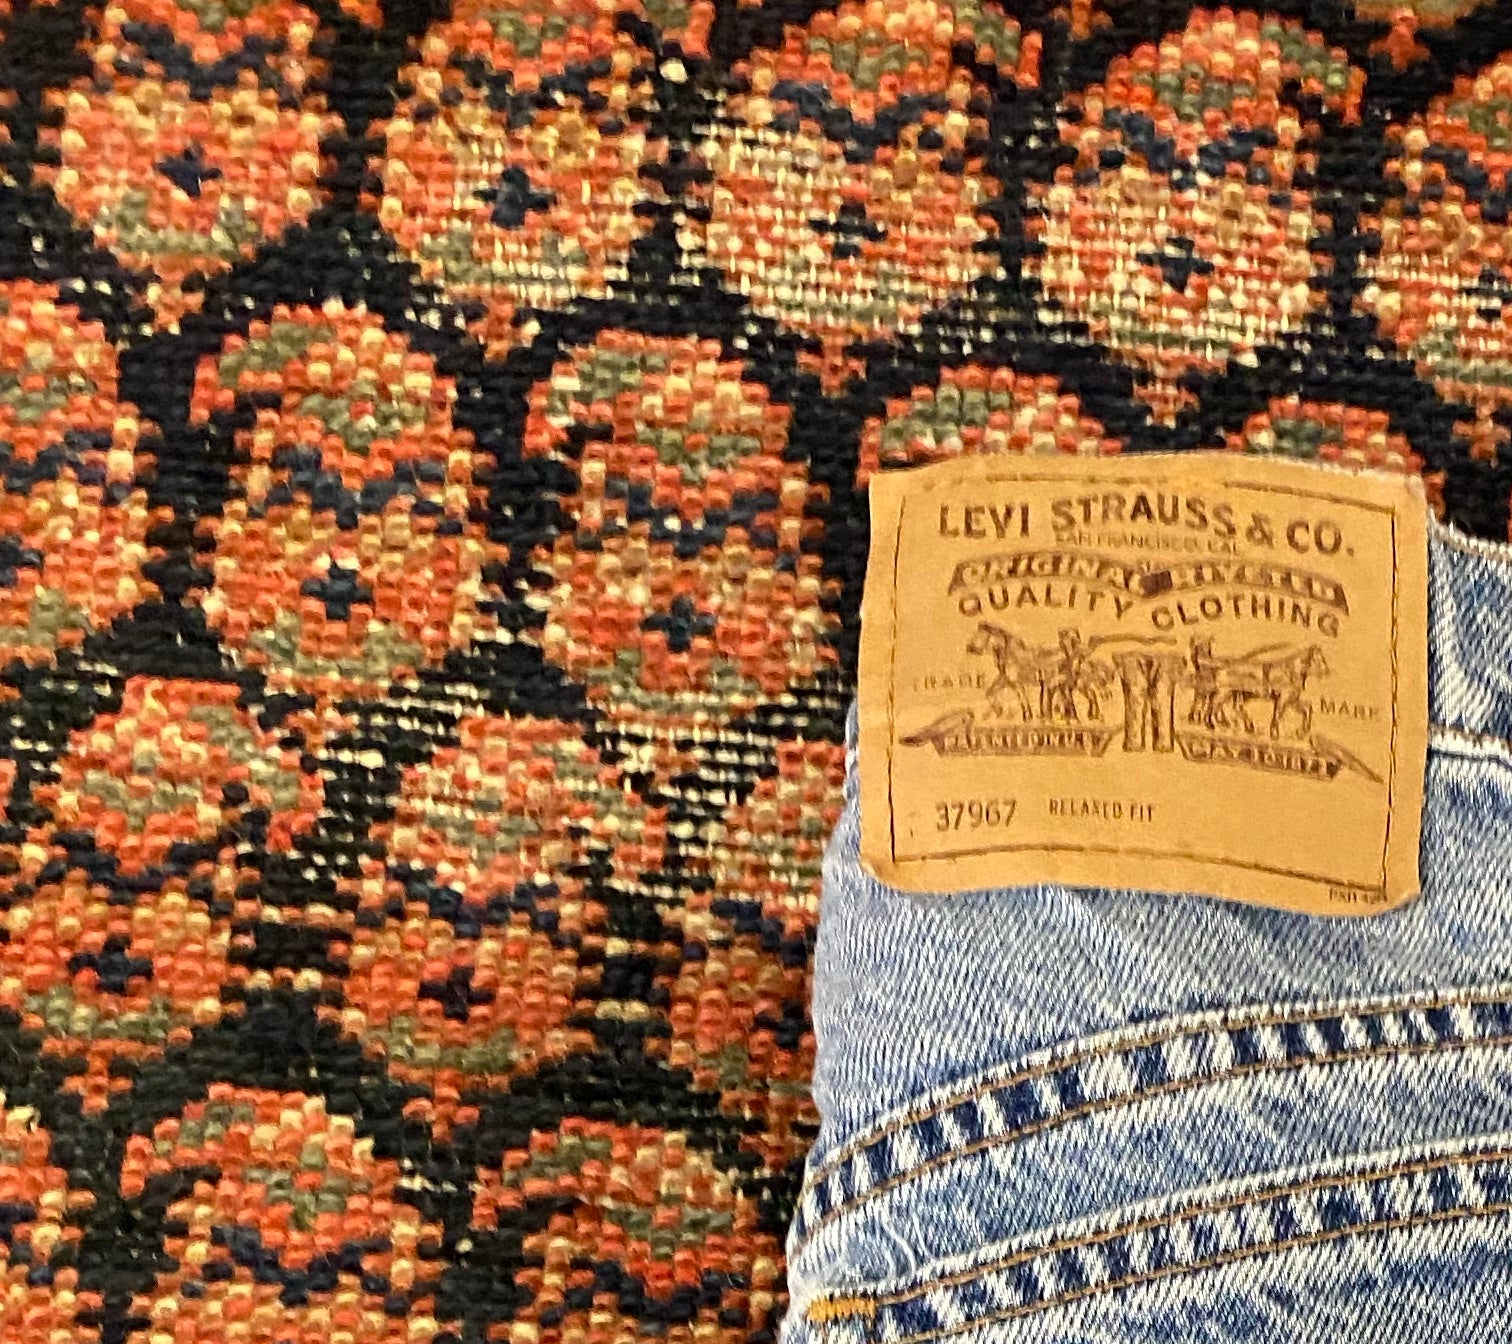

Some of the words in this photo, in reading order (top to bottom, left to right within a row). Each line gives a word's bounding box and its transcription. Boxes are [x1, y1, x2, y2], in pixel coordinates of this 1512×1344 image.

[939, 501, 1030, 539] LEVI
[1051, 492, 1236, 539] STRAUSS
[1245, 511, 1274, 549] &
[1286, 519, 1355, 557] CO.
[958, 583, 1135, 621] QUALITY
[1151, 593, 1341, 639] CLOTHING
[935, 798, 1017, 832] 37967
[1048, 798, 1123, 821] RELAXED
